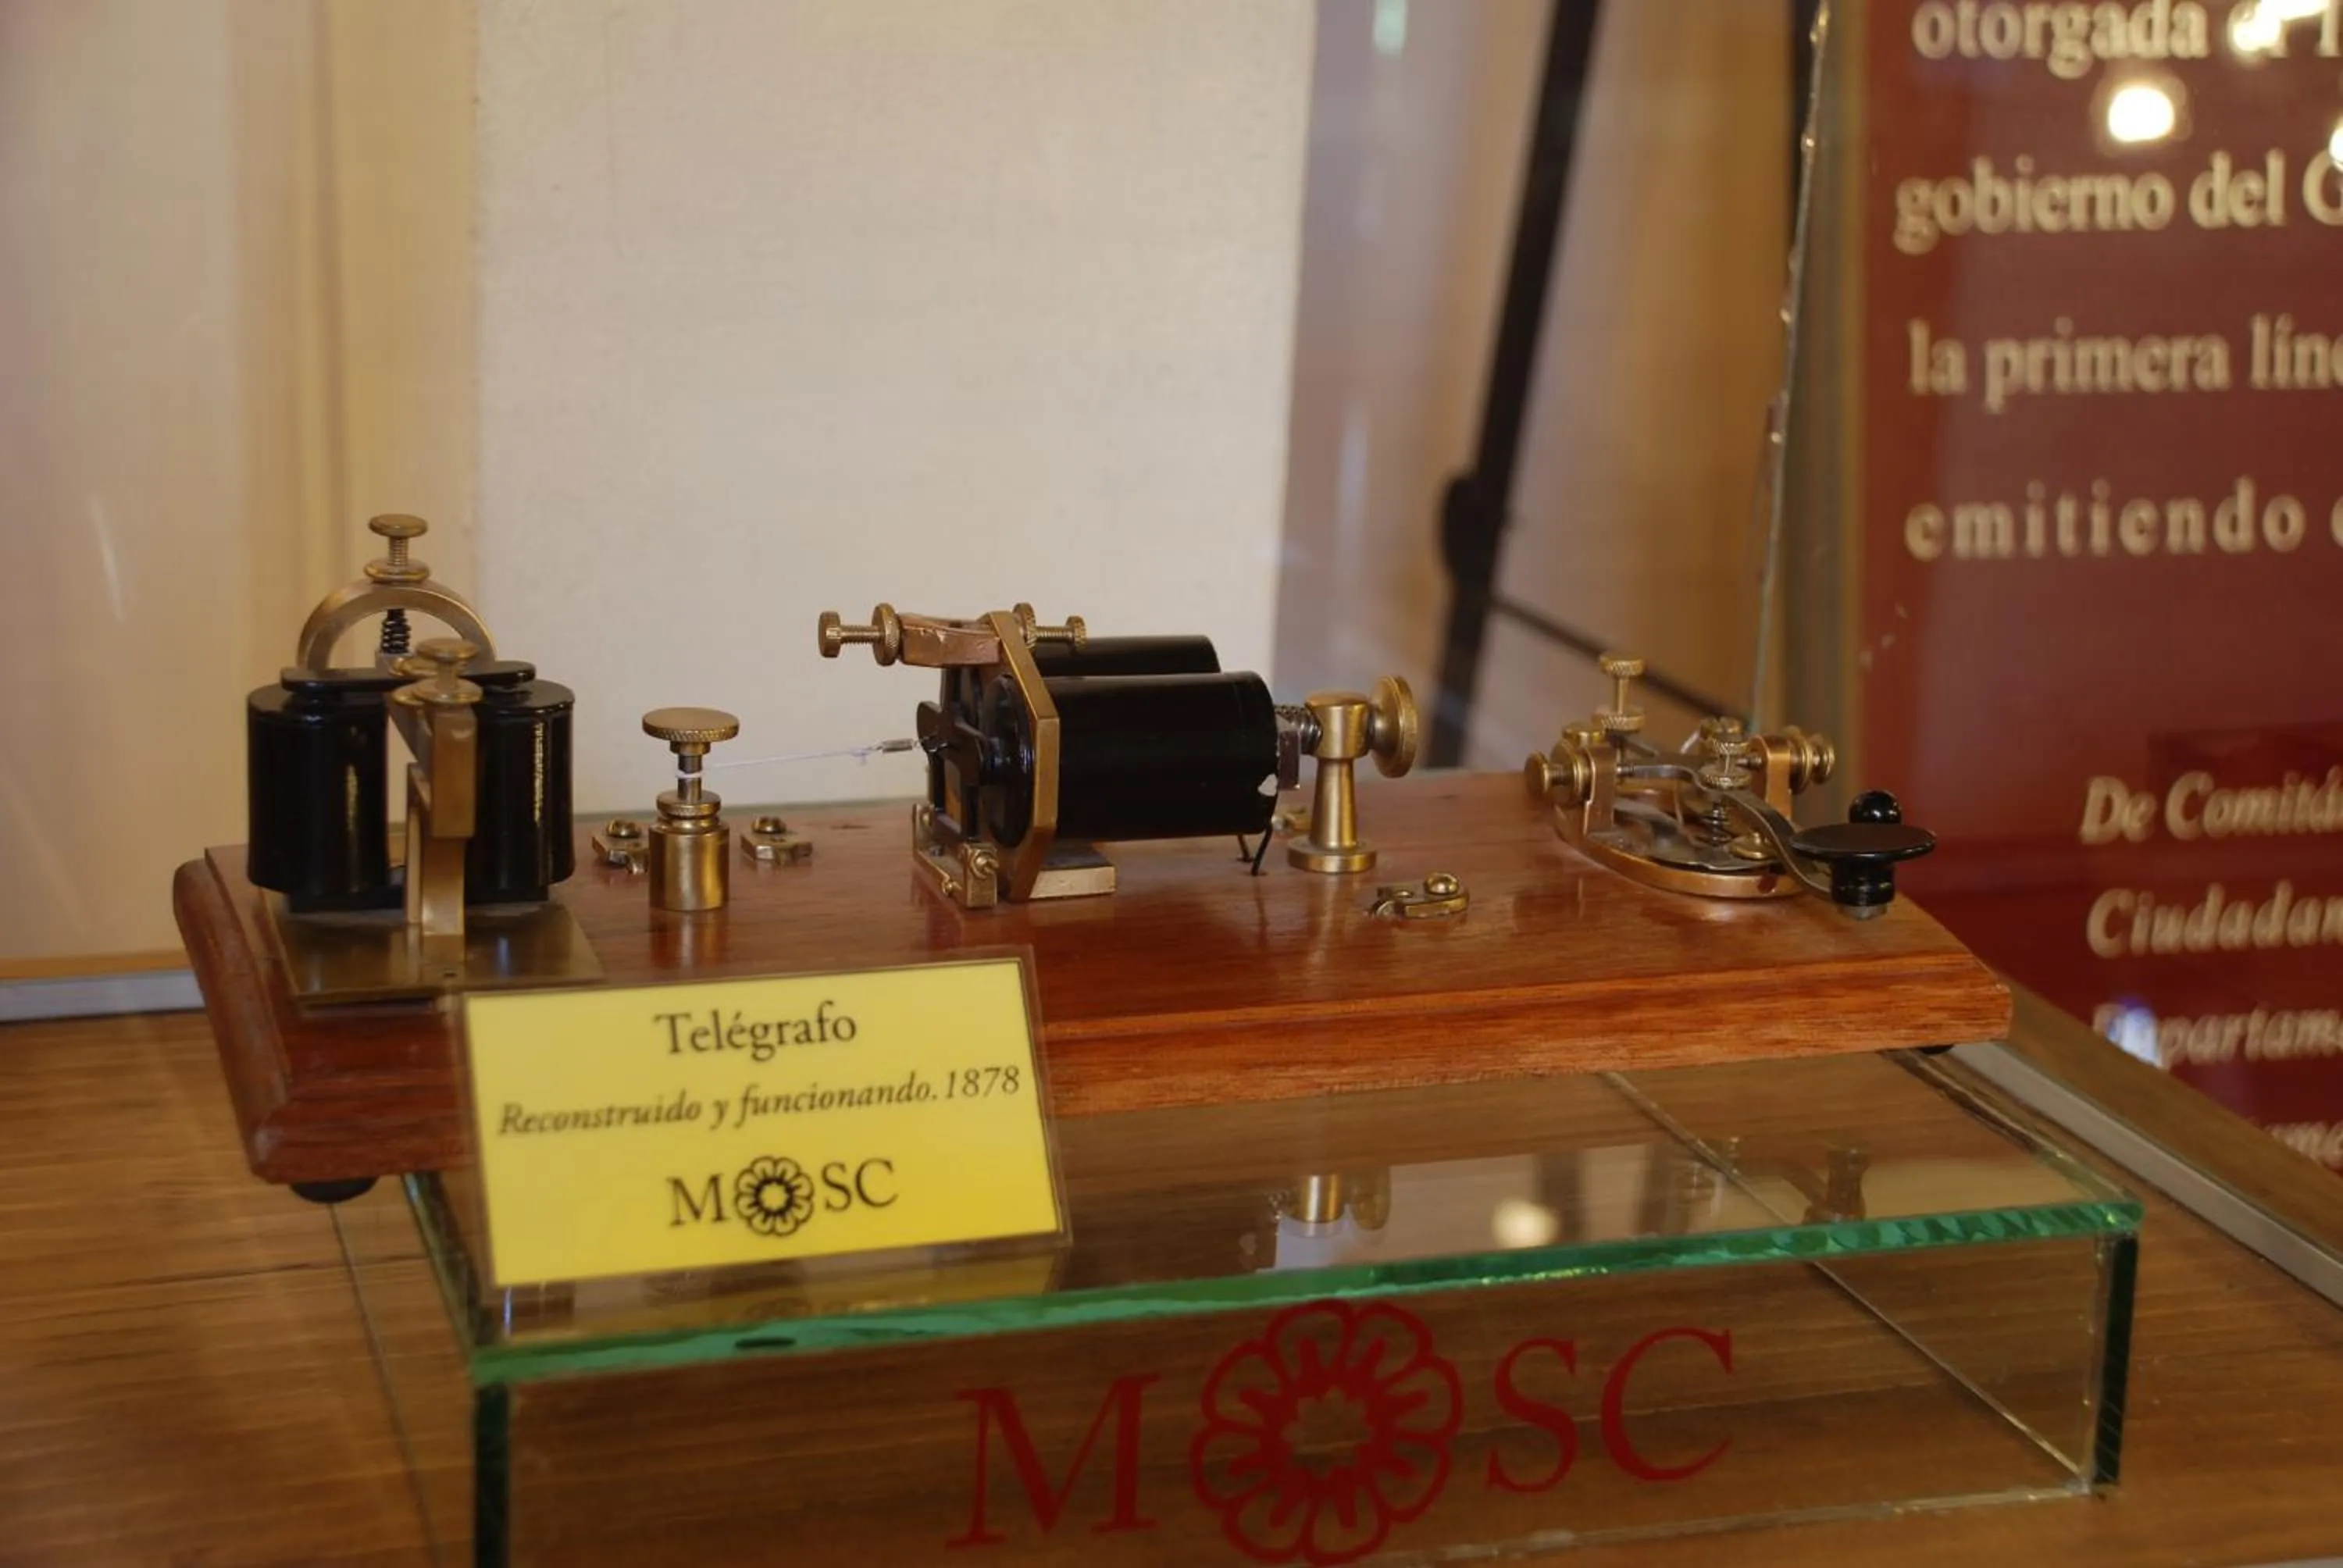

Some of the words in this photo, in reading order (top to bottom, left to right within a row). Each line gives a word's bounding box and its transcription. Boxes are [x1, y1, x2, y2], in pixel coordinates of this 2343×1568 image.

[1911, 0, 2209, 78] otorgada
[1893, 154, 2176, 255] gobierno
[2188, 148, 2287, 230] del
[1909, 317, 1967, 395] la
[1985, 315, 2231, 415] primera
[1903, 474, 2306, 561] emitiendo
[2079, 775, 2158, 845] De
[654, 1000, 858, 1063] Telégrafo
[497, 1089, 703, 1135] Reconstruido
[711, 1099, 731, 1131] y
